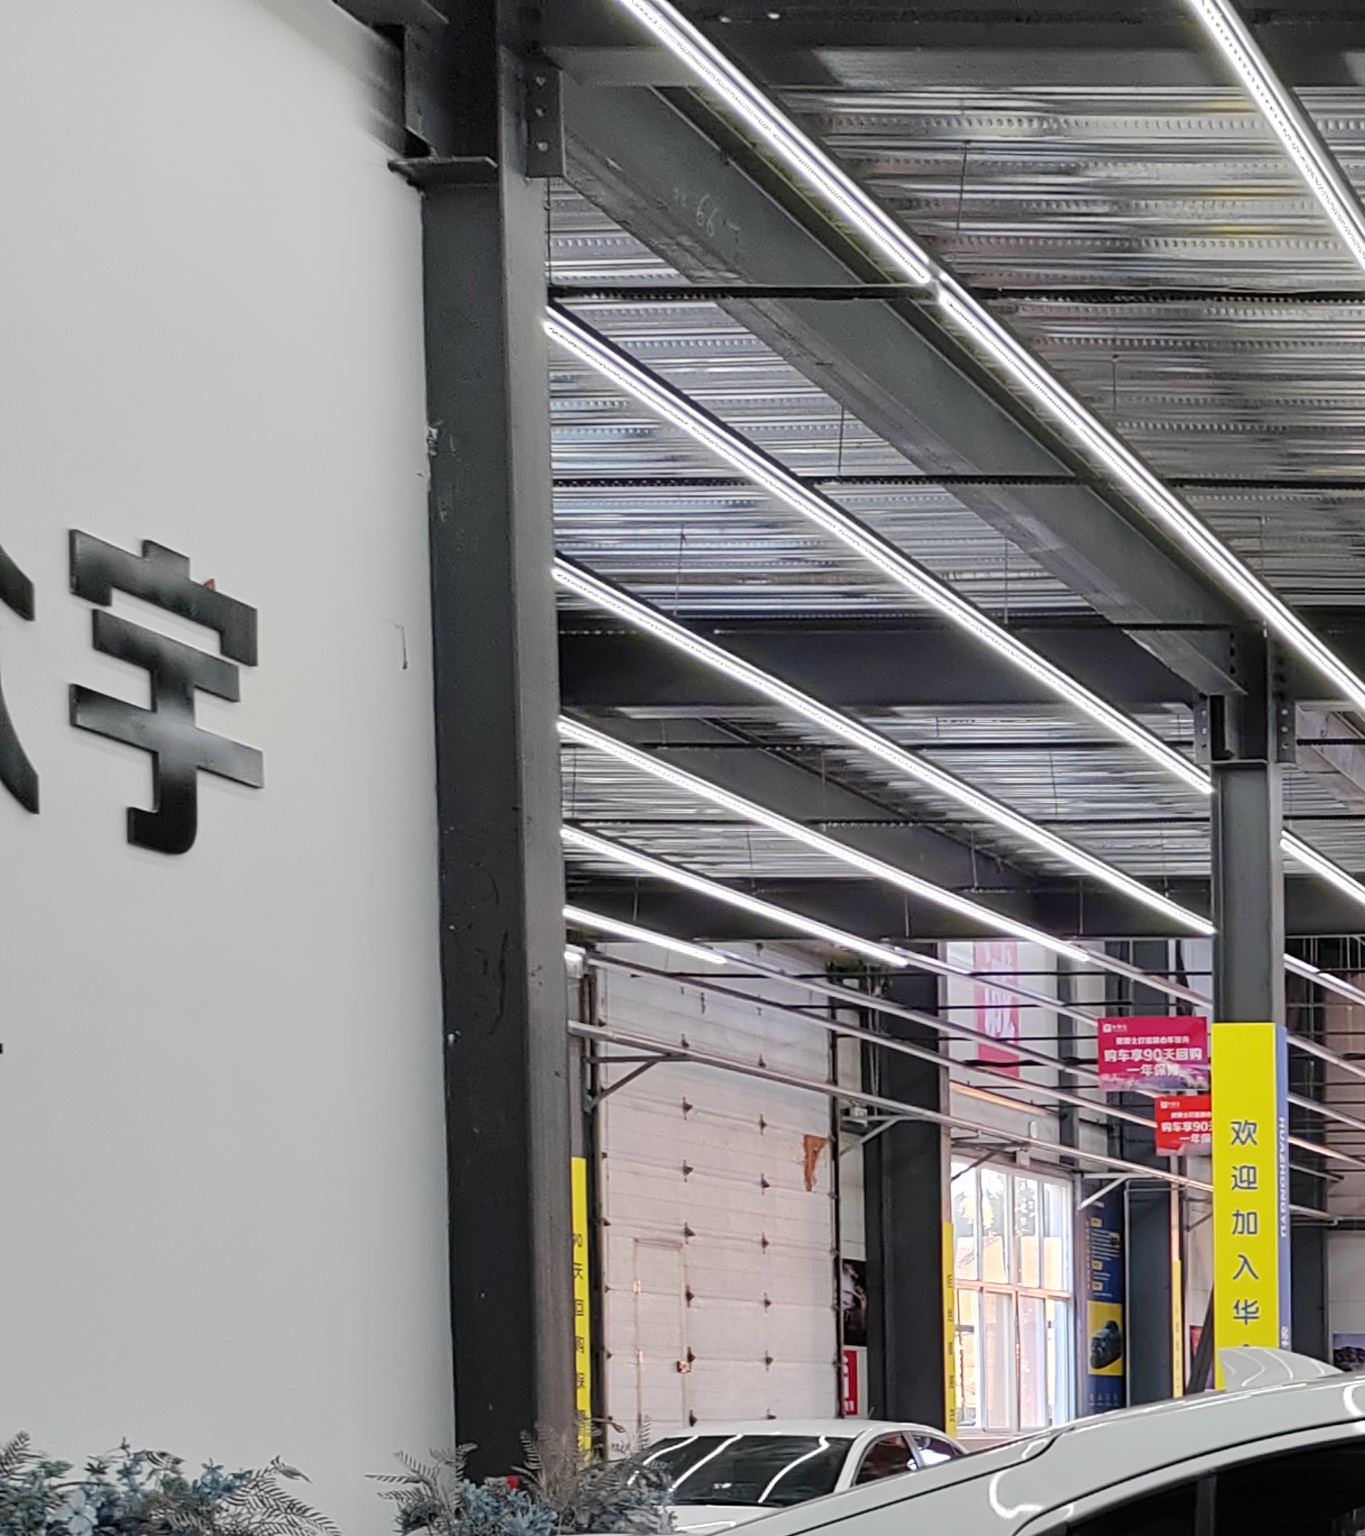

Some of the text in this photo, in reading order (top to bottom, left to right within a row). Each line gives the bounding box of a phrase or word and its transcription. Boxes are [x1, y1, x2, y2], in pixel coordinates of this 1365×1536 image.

[0, 528, 264, 853] 宇
[1104, 1048, 1202, 1062] 购车享90天回购
[1230, 1120, 1260, 1348] 欢迎加入华
